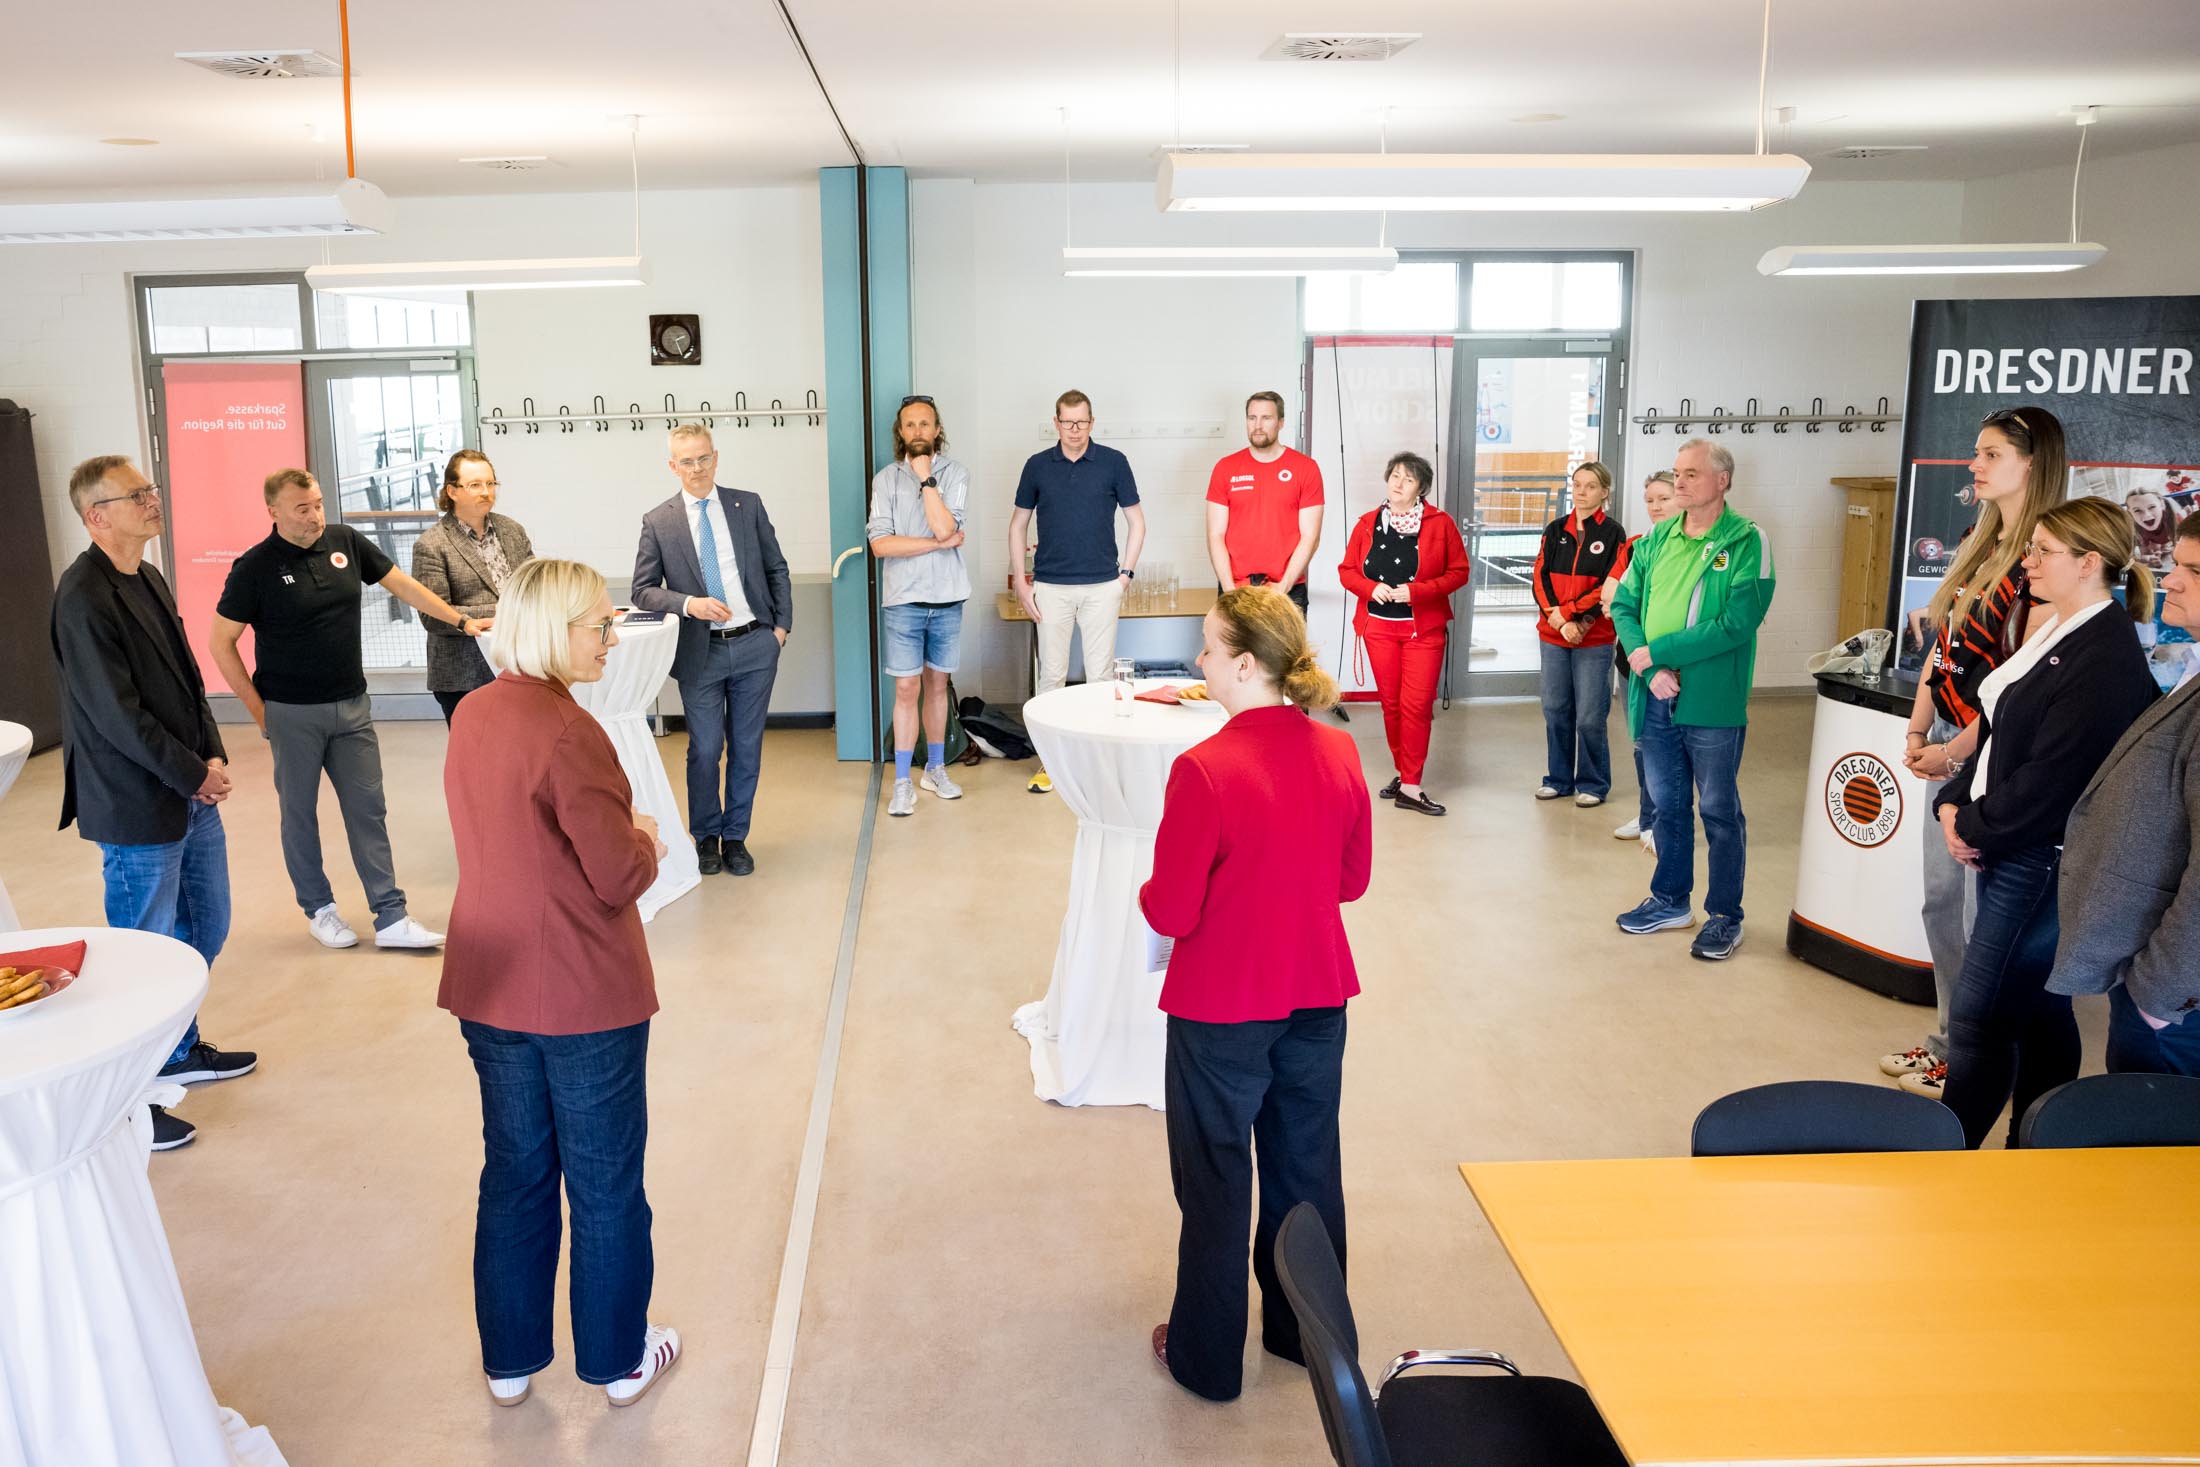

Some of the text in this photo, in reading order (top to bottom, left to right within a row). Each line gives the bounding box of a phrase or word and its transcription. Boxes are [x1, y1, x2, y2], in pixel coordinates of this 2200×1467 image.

[1934, 347, 2193, 395] DRESDNER
[282, 575, 296, 585] TR
[1834, 758, 1895, 798] DRESDNER
[1830, 791, 1896, 842] SPORTCLUB 1898
